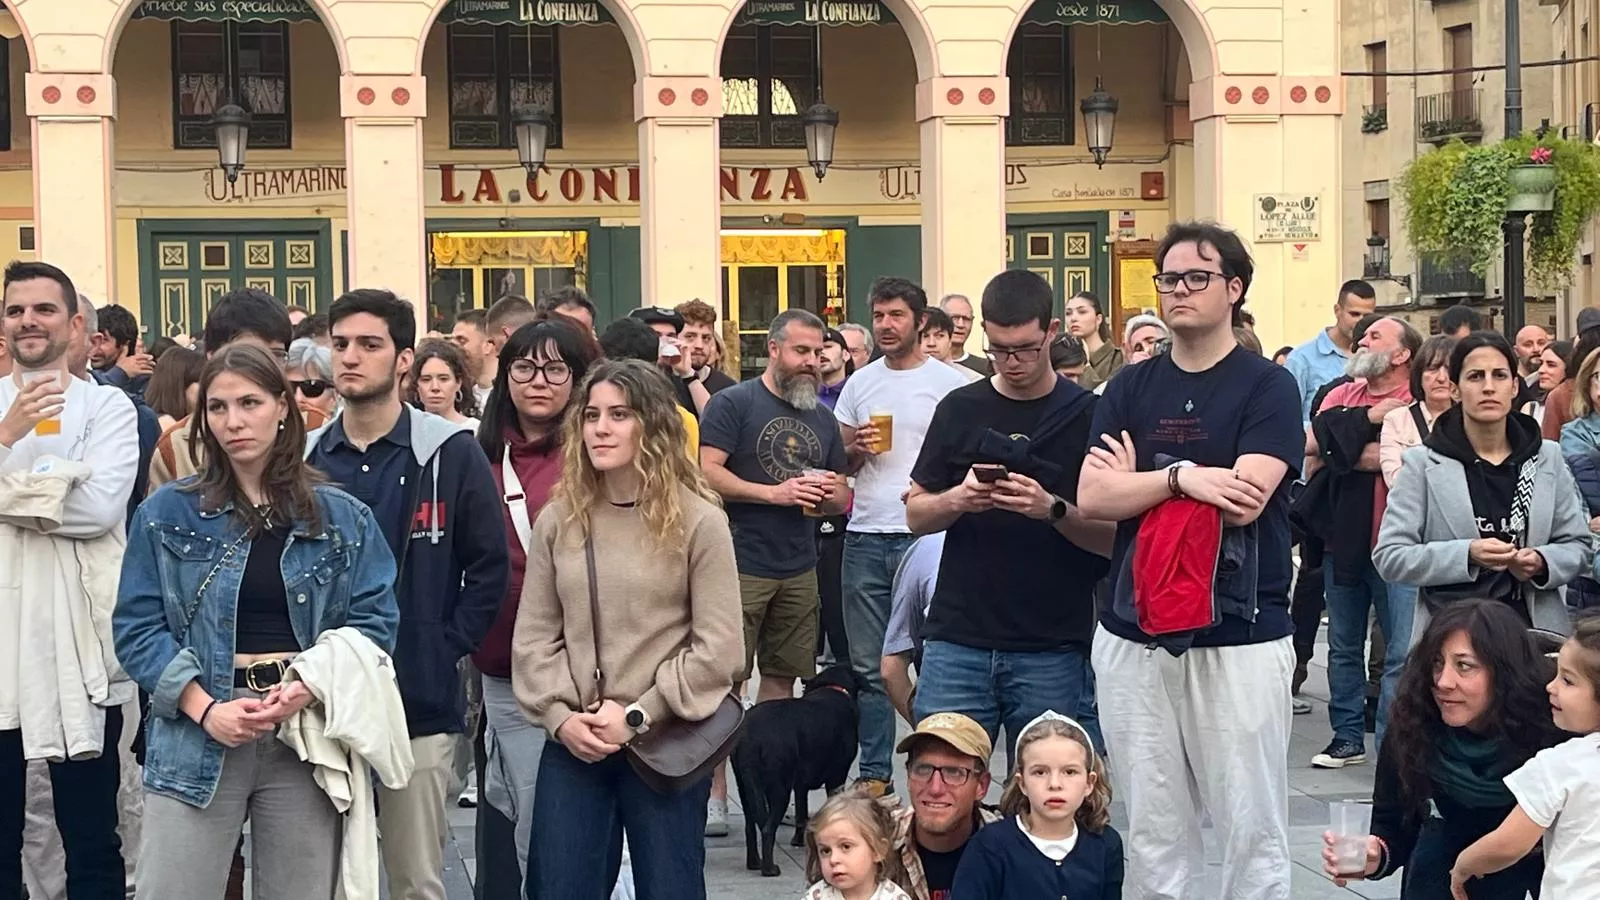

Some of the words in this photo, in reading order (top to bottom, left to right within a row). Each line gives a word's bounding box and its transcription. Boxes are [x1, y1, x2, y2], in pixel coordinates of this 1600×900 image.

[519, 1, 534, 21] LA
[537, 2, 599, 21] CONFIANZA
[805, 1, 819, 21] LA
[821, 1, 881, 21] CONFIANZA
[1056, 2, 1089, 17] desde
[1096, 4, 1120, 19] 1871
[439, 164, 503, 202] LA
